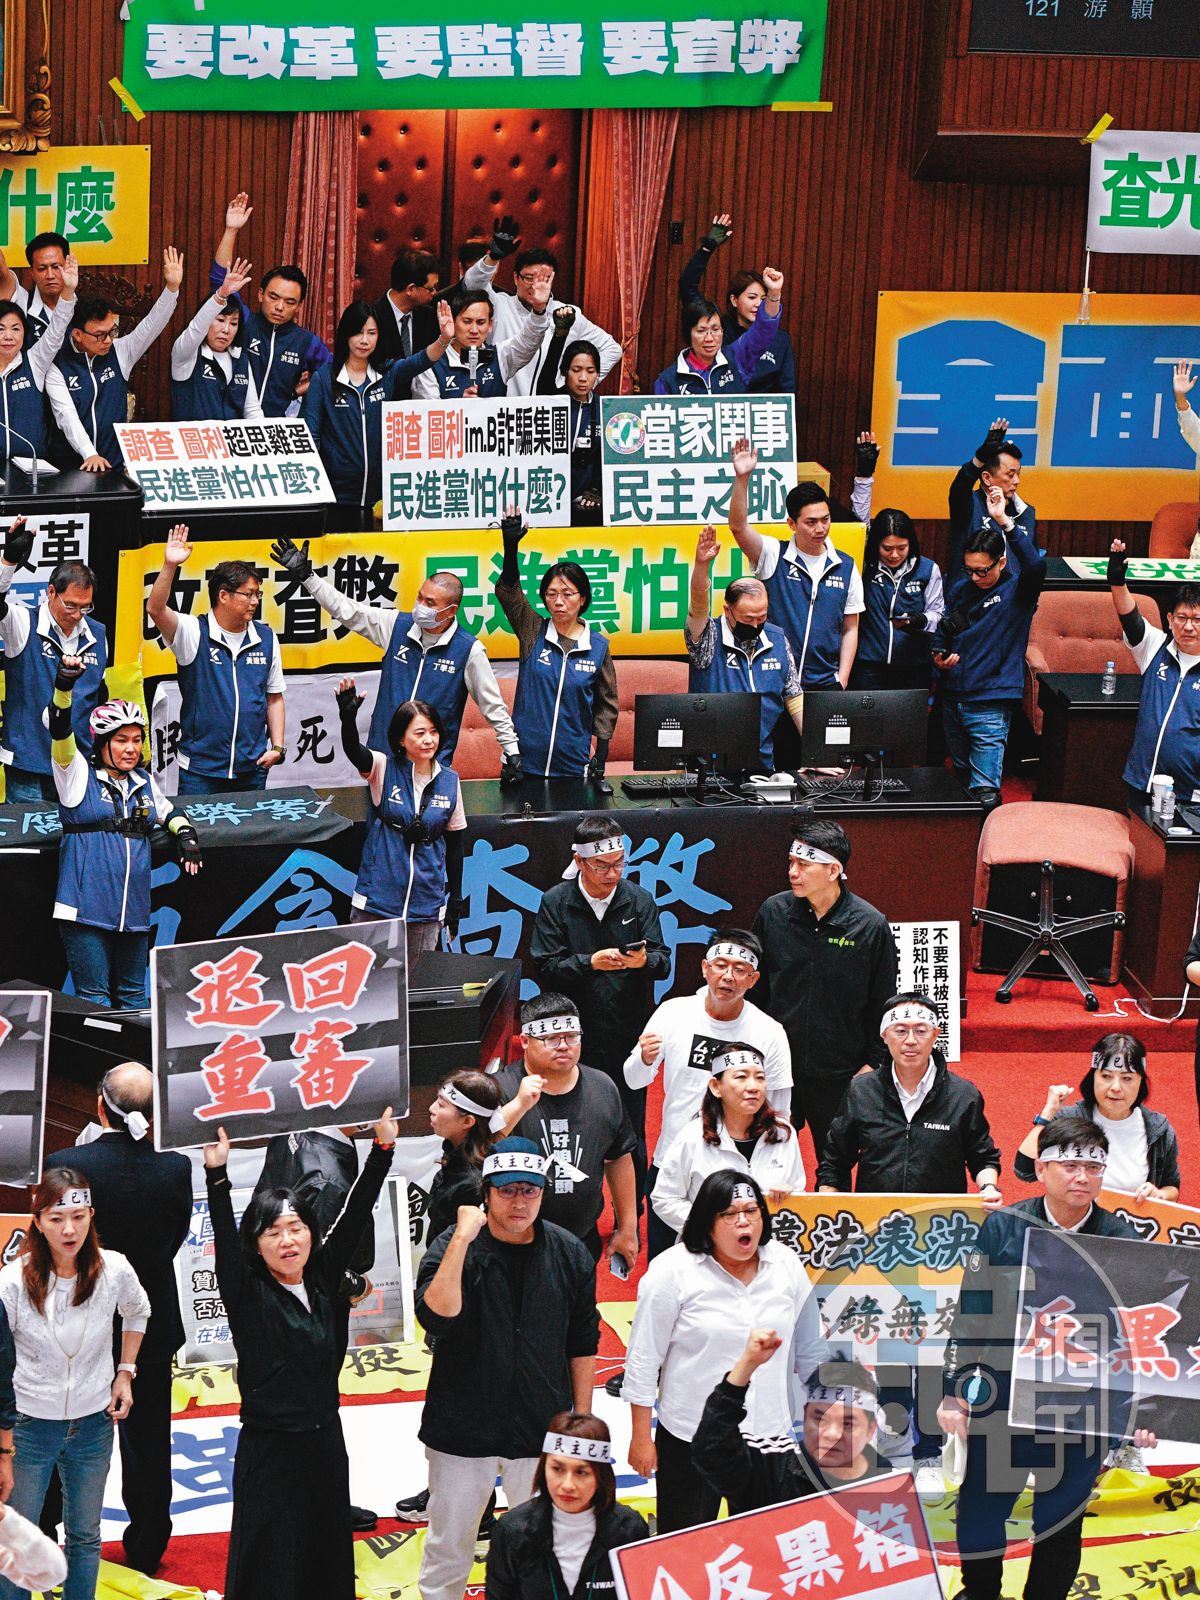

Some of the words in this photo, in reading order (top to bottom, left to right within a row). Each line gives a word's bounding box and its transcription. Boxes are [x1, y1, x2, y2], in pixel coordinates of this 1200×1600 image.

[1025, 0, 1059, 17] 121
[146, 24, 358, 80] 要改革
[376, 22, 584, 80] 要監督
[602, 19, 803, 76] 要查弊
[120, 429, 179, 463] 調查
[181, 424, 315, 460] 圖利超思雞蛋
[385, 411, 422, 461] 調查
[427, 405, 569, 460] 圖利im.B詐騙集團
[640, 401, 789, 459] 當家鬧事
[136, 461, 321, 503] 民進黨怕什麼?
[388, 465, 567, 521] 民進黨怕什麼?
[610, 468, 787, 523] 民主之恥
[142, 555, 400, 650] 改查弊
[433, 662, 456, 674] 丁學忠
[293, 715, 335, 764] 死
[187, 941, 376, 1029] 退回
[932, 926, 949, 1058] 不要再被民進黨
[193, 1018, 376, 1122] 重審
[923, 1122, 951, 1132] TAIWAN
[766, 1207, 980, 1272] 違法表決
[196, 1326, 232, 1343] 在場
[1020, 1296, 1200, 1381] 反黑
[705, 1499, 921, 1600] 反黑箱
